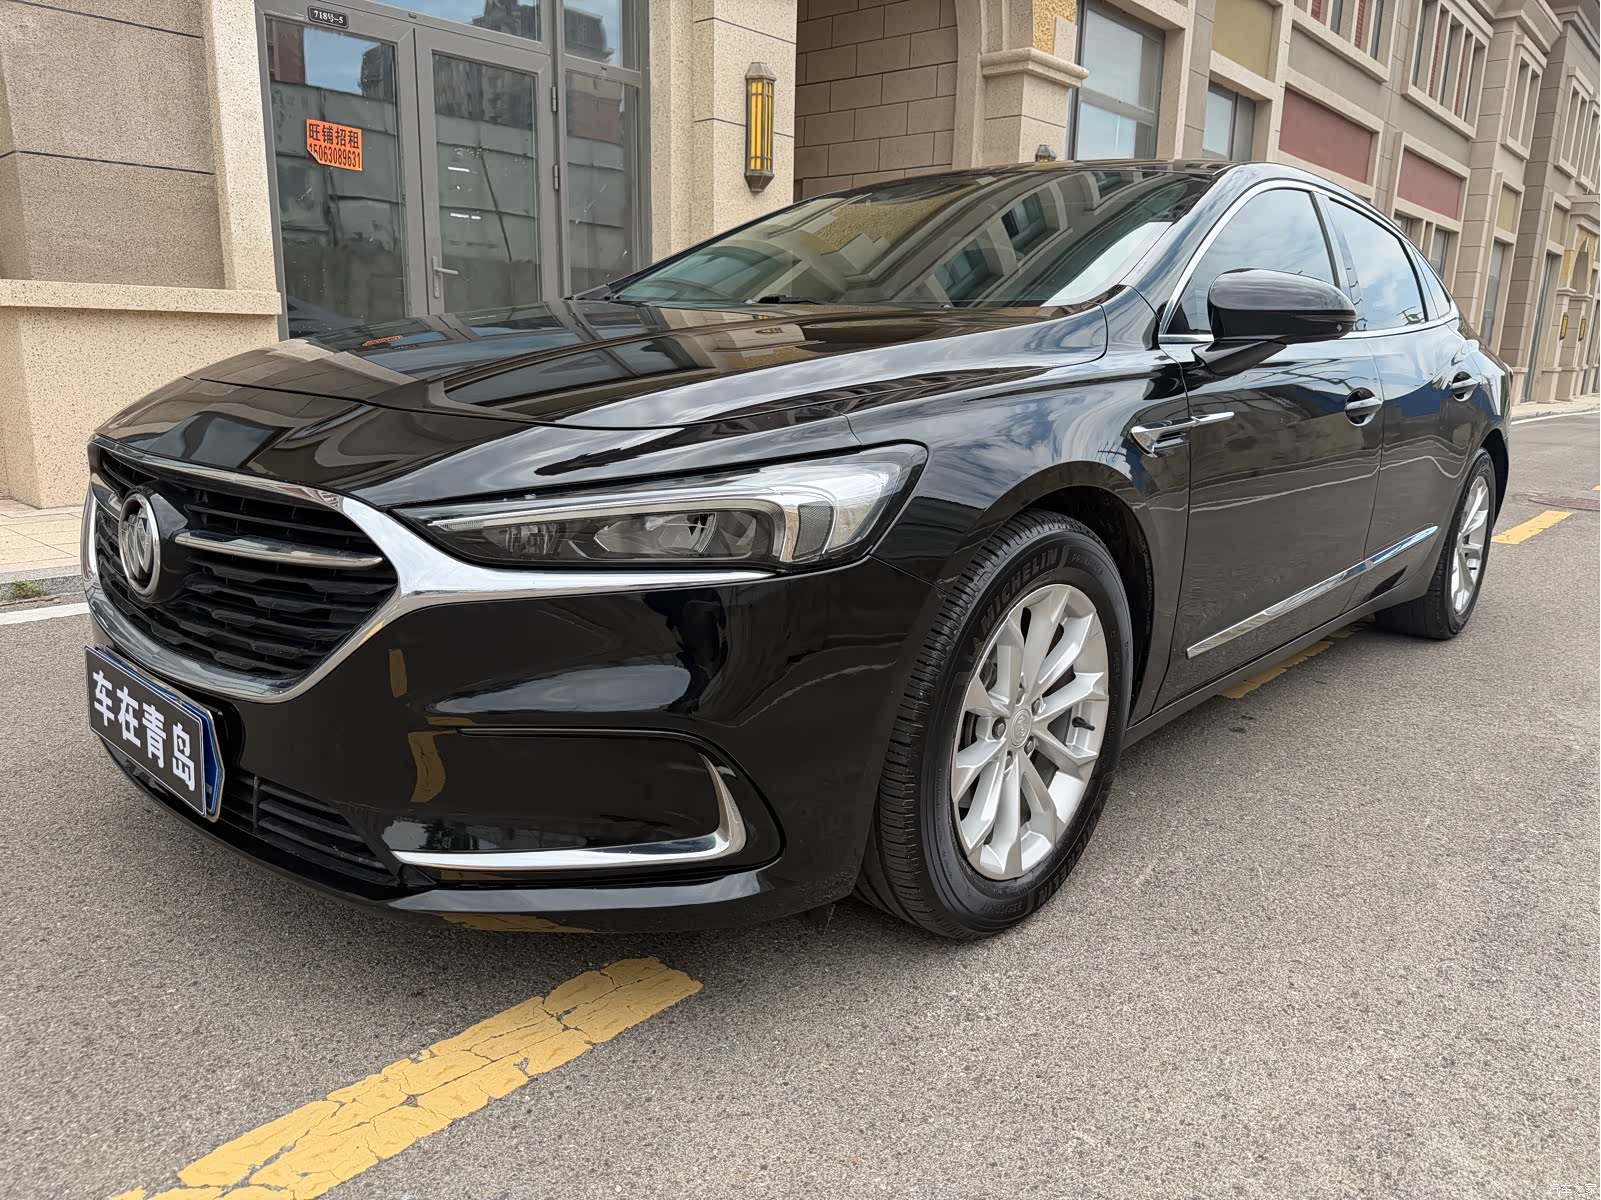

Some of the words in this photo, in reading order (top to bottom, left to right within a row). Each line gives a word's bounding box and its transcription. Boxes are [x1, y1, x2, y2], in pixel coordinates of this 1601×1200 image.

[309, 123, 360, 149] 旺铺招租
[980, 547, 1058, 636] MICHELIN
[92, 669, 195, 791] 车在青岛
